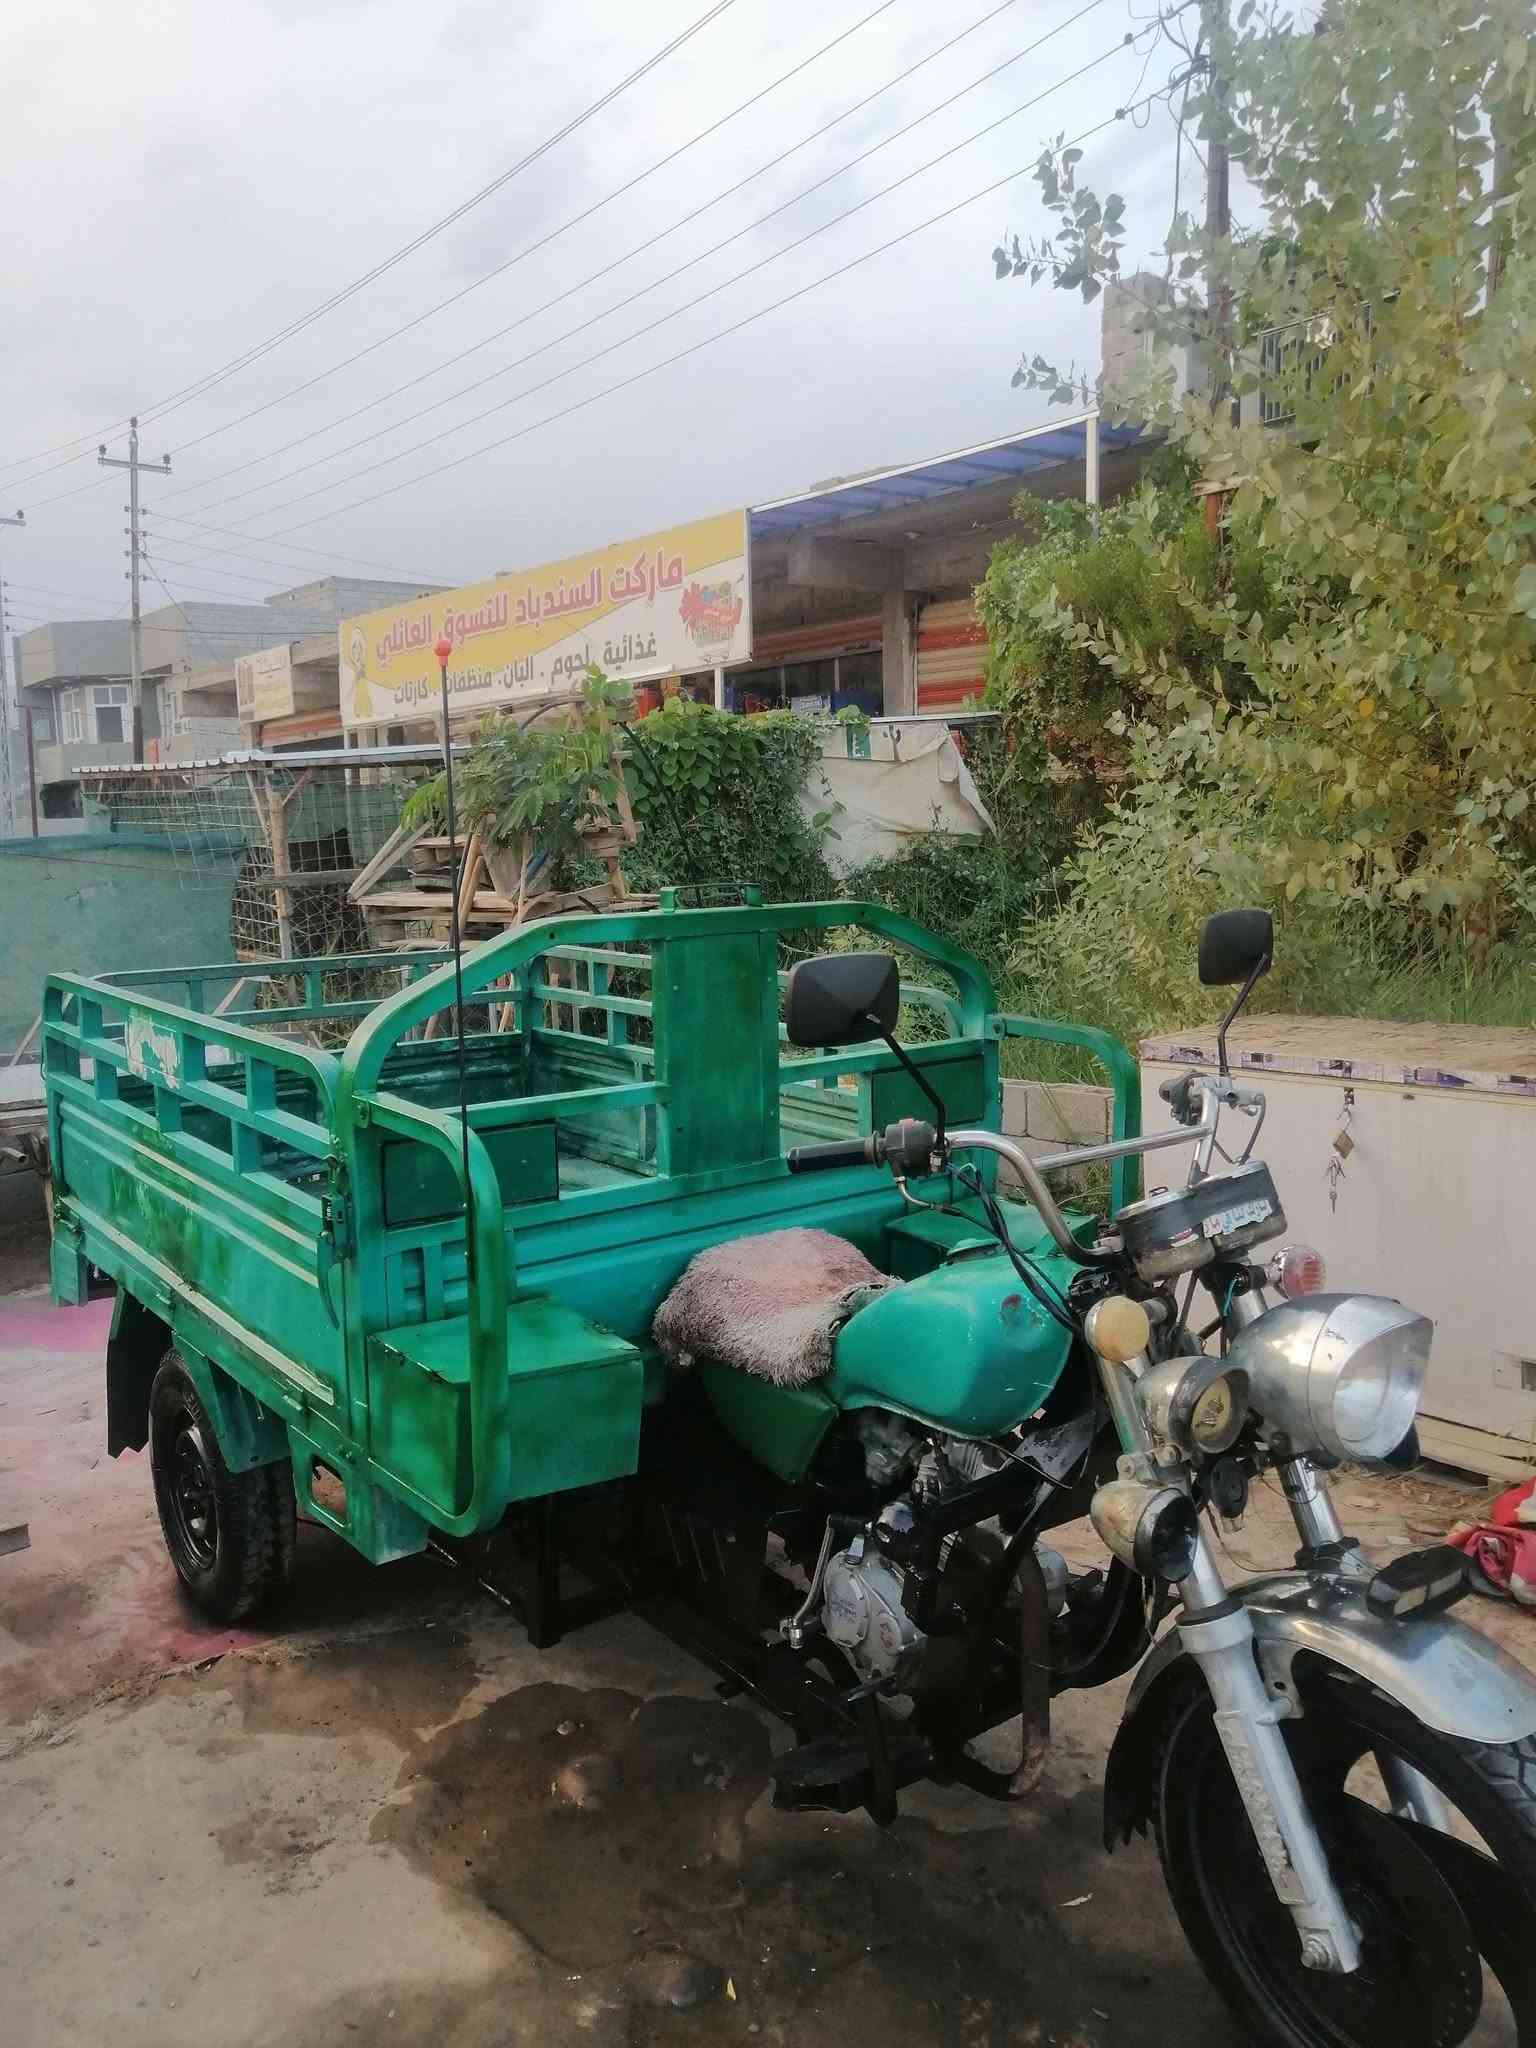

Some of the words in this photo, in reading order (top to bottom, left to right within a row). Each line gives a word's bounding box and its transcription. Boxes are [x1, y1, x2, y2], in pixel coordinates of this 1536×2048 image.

[514, 567, 602, 628] السندباد
[610, 550, 683, 605] ماركت
[376, 613, 432, 667] العائلي
[438, 592, 508, 644] للتسوق
[551, 644, 590, 685] لحوم
[603, 632, 657, 671] غذائية
